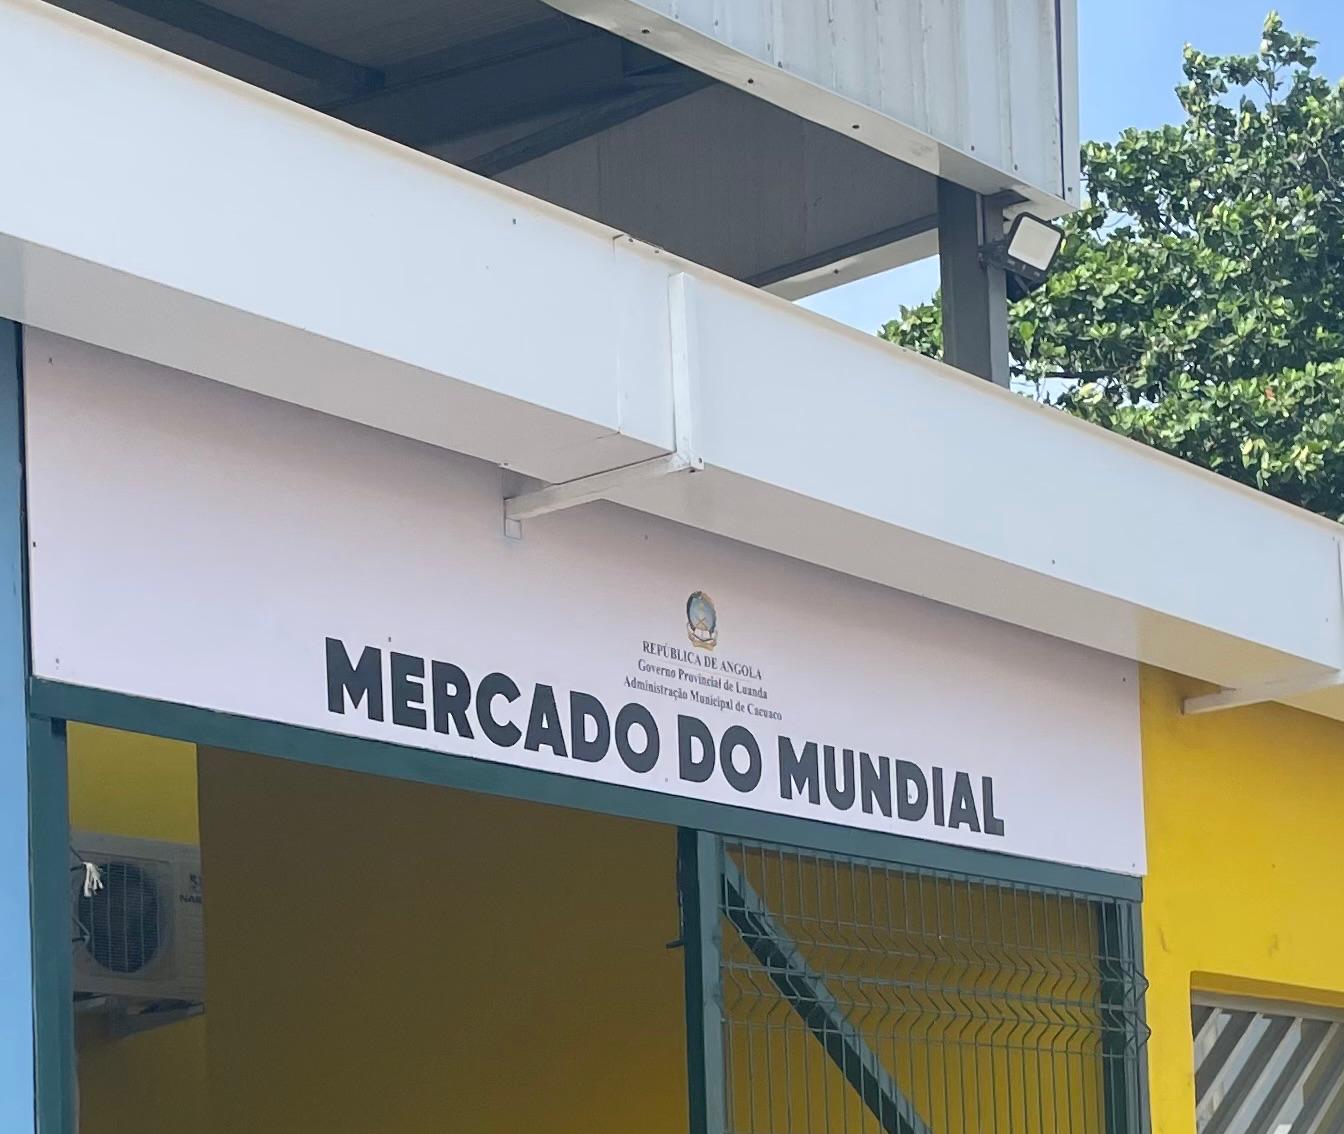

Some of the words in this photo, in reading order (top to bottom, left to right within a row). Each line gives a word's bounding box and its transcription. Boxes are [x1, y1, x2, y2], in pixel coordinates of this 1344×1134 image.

[638, 659, 676, 678] Governo
[678, 668, 721, 689] Provincial
[723, 679, 734, 691] de
[736, 681, 768, 700] Luanda
[642, 640, 701, 666] REPÚBLICA
[704, 656, 717, 670] DE
[720, 660, 762, 680] ANGOLA
[624, 675, 688, 701] Administração
[690, 689, 733, 711] Municipal
[735, 701, 745, 713] de
[747, 703, 783, 721] Cacuaco
[325, 636, 661, 774] MERCADO
[677, 713, 763, 793] DO
[777, 735, 1005, 837] MUNDIAL
